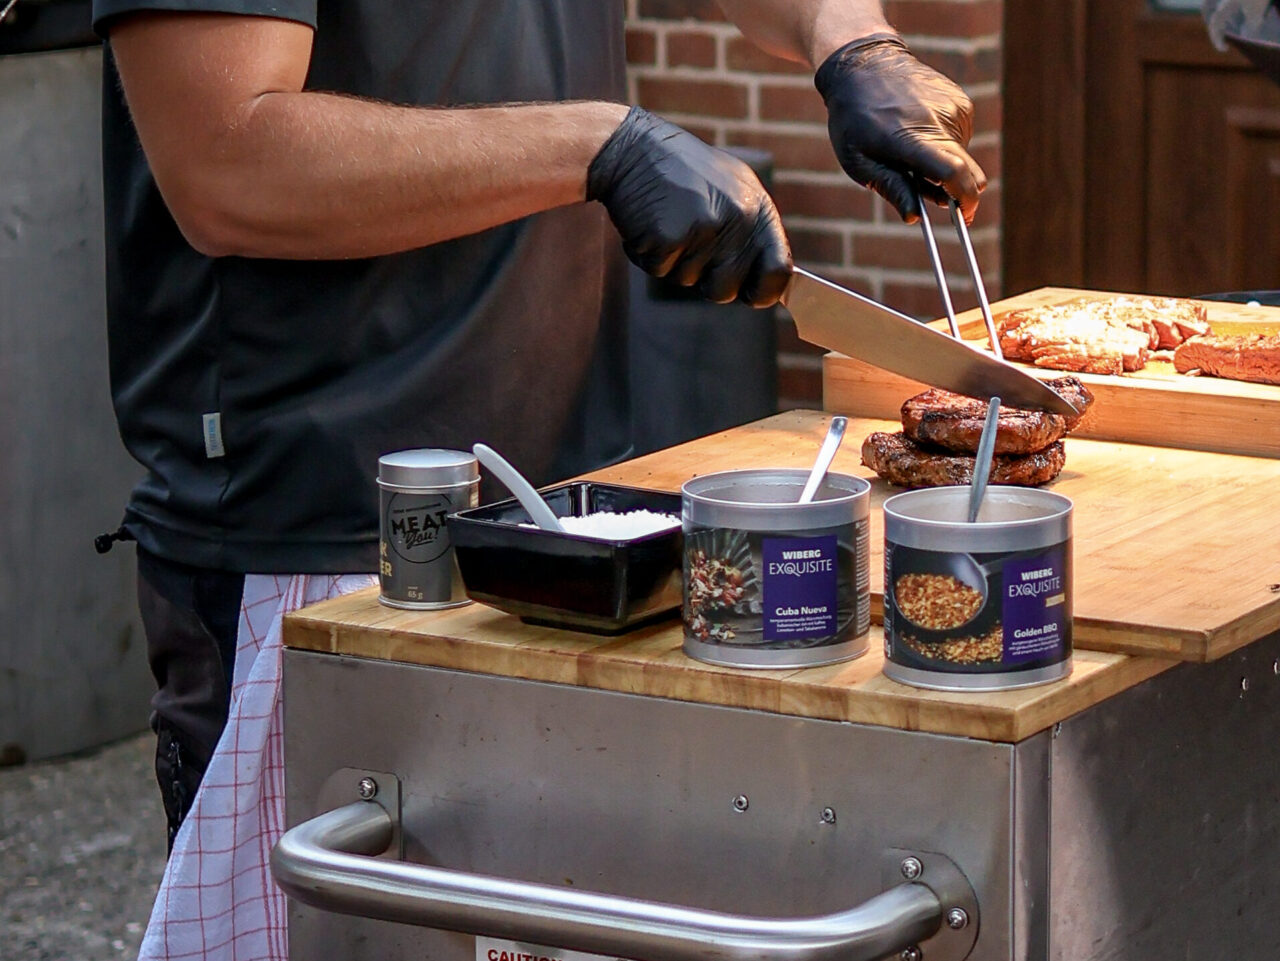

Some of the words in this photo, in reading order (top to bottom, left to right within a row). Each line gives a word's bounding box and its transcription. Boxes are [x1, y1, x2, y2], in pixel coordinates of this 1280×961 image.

[391, 510, 448, 539] MEAT
[782, 549, 821, 560] WIBERG
[769, 558, 832, 577] EXQUISITE
[1021, 567, 1053, 581] WIBERG
[1008, 576, 1060, 597] EXQUISITE
[775, 606, 799, 616] Cuba
[801, 606, 827, 615] Nueva
[1014, 627, 1042, 638] Golden
[1043, 622, 1058, 633] BBQ
